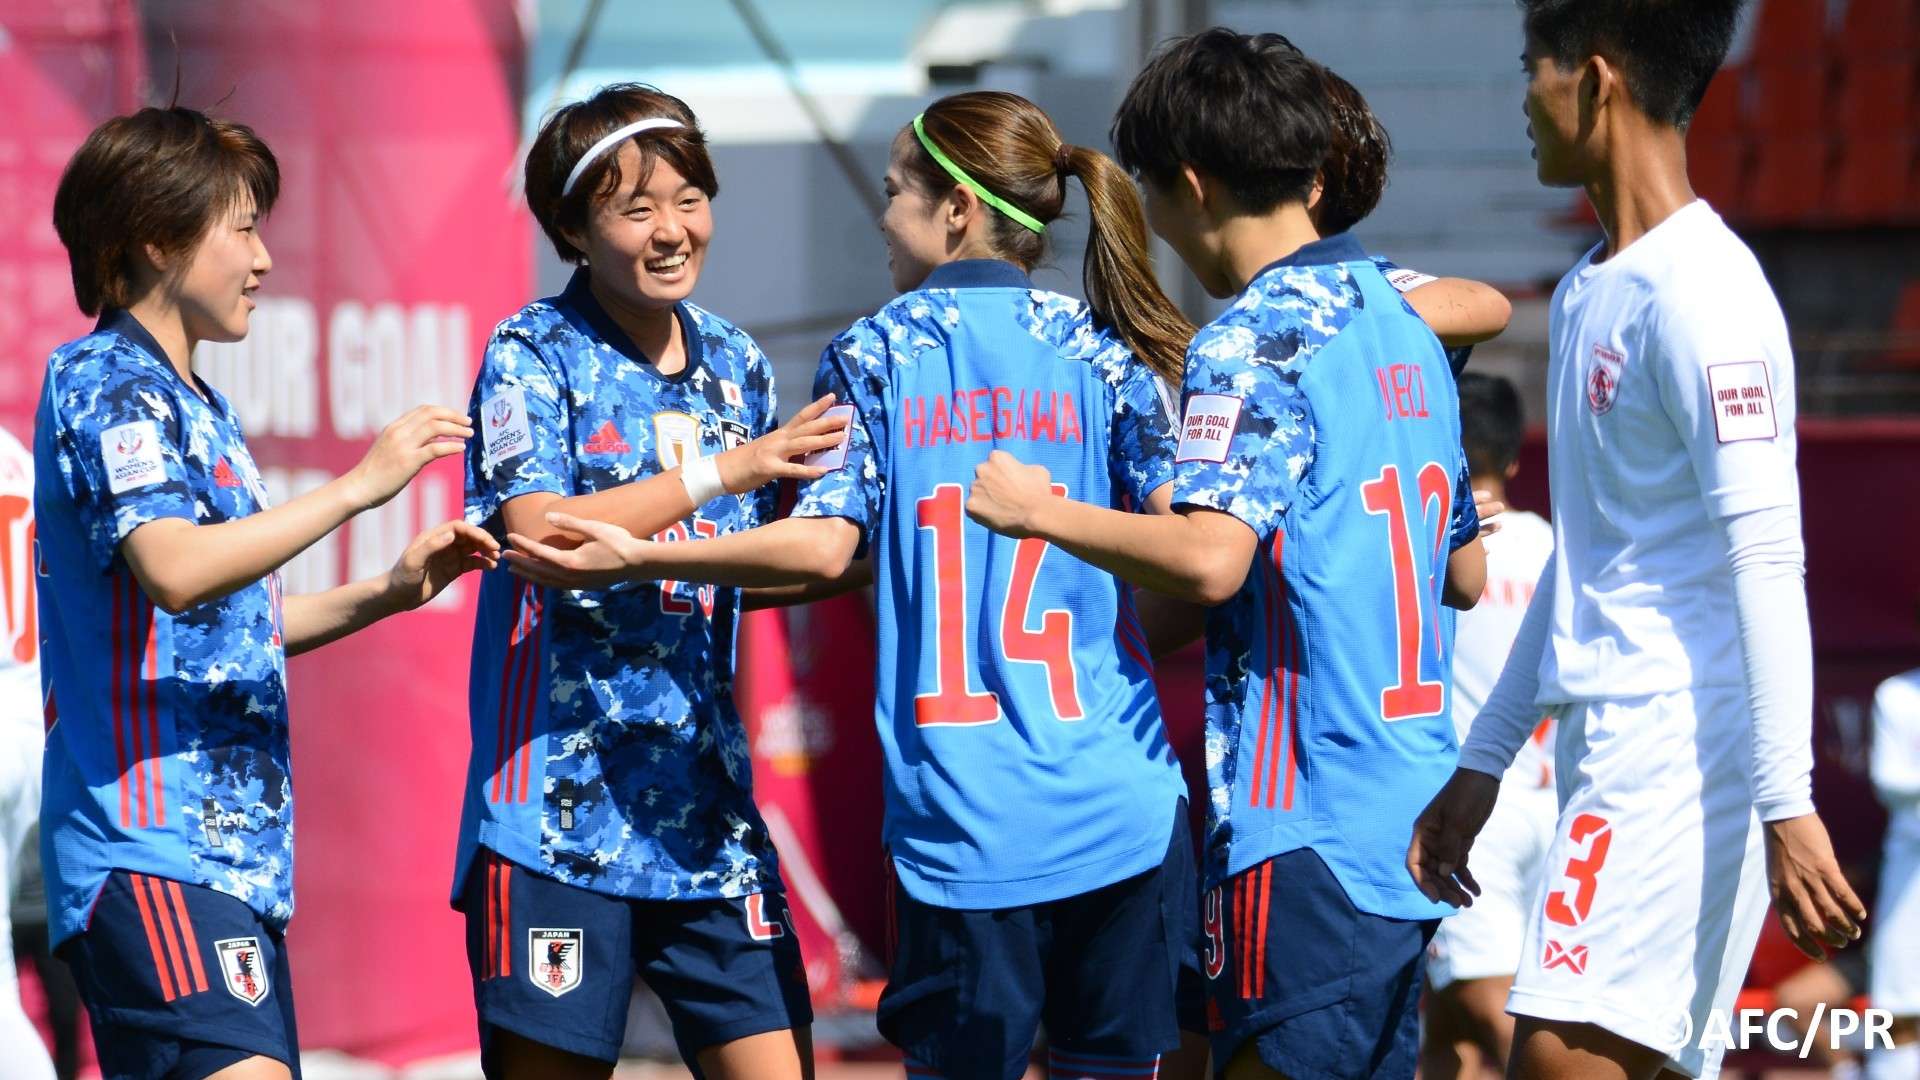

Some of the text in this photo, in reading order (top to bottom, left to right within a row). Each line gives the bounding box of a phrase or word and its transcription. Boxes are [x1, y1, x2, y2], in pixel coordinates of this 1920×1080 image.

[1717, 385, 1766, 402] OUR GOAL
[904, 386, 1083, 449] HASEGAWA
[1725, 402, 1764, 417] FOR ALL
[1187, 414, 1230, 429] OUR GOAL
[490, 429, 521, 449] WOMEN'S
[1186, 428, 1221, 441] FOR ALL
[489, 441, 509, 455] ASIAN
[508, 433, 524, 446] CUP
[914, 483, 1085, 728] 14
[1545, 814, 1612, 927] 3
[545, 974, 567, 984] JFA
